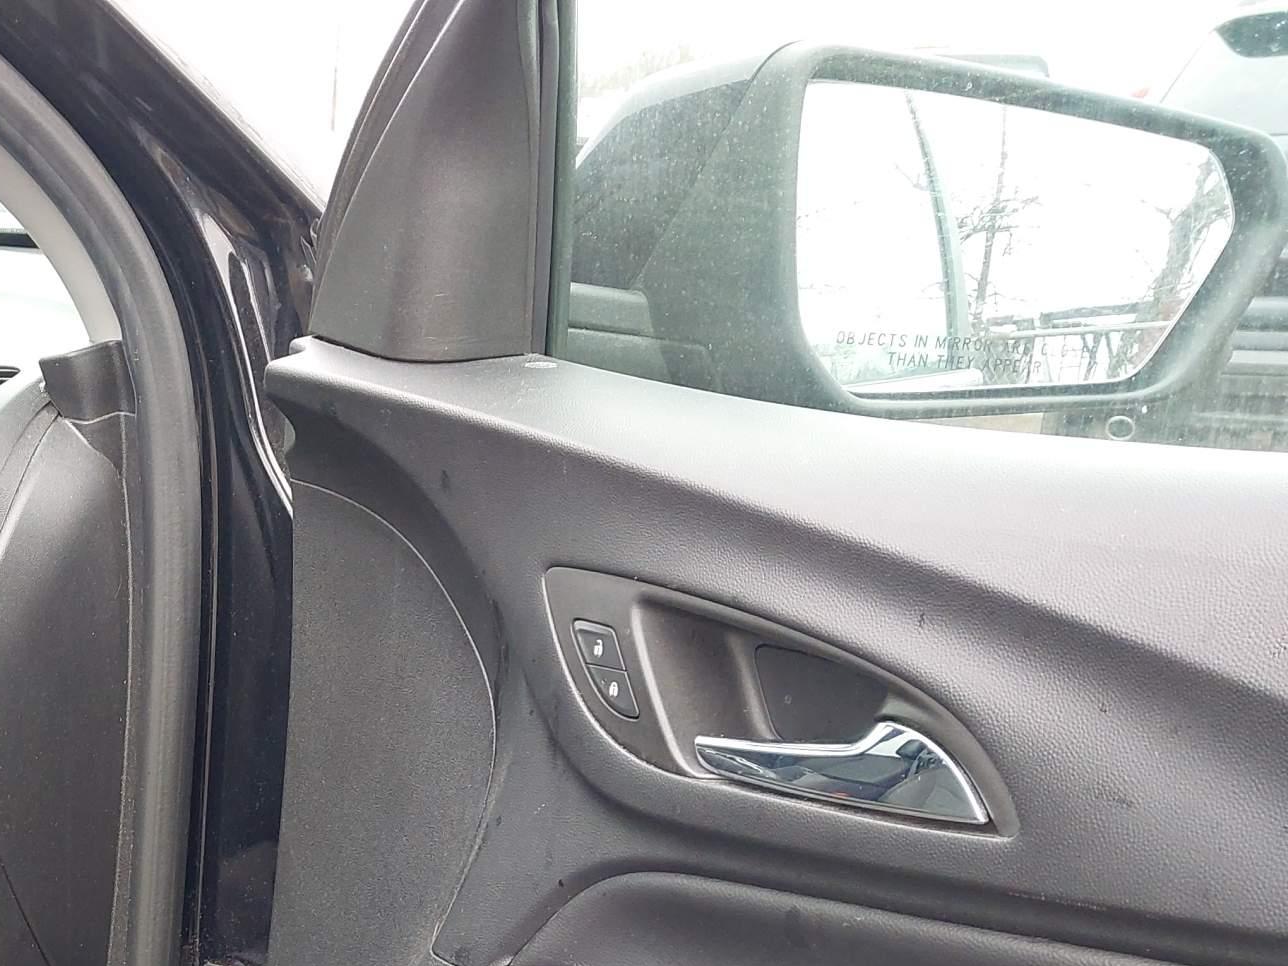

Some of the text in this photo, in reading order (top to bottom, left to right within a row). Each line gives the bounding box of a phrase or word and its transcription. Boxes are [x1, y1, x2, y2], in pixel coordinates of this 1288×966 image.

[835, 331, 909, 348] OBJECTS
[914, 334, 929, 348] IN
[935, 336, 993, 352] MIRROR
[887, 352, 929, 368] THAN
[937, 354, 976, 369] THEY
